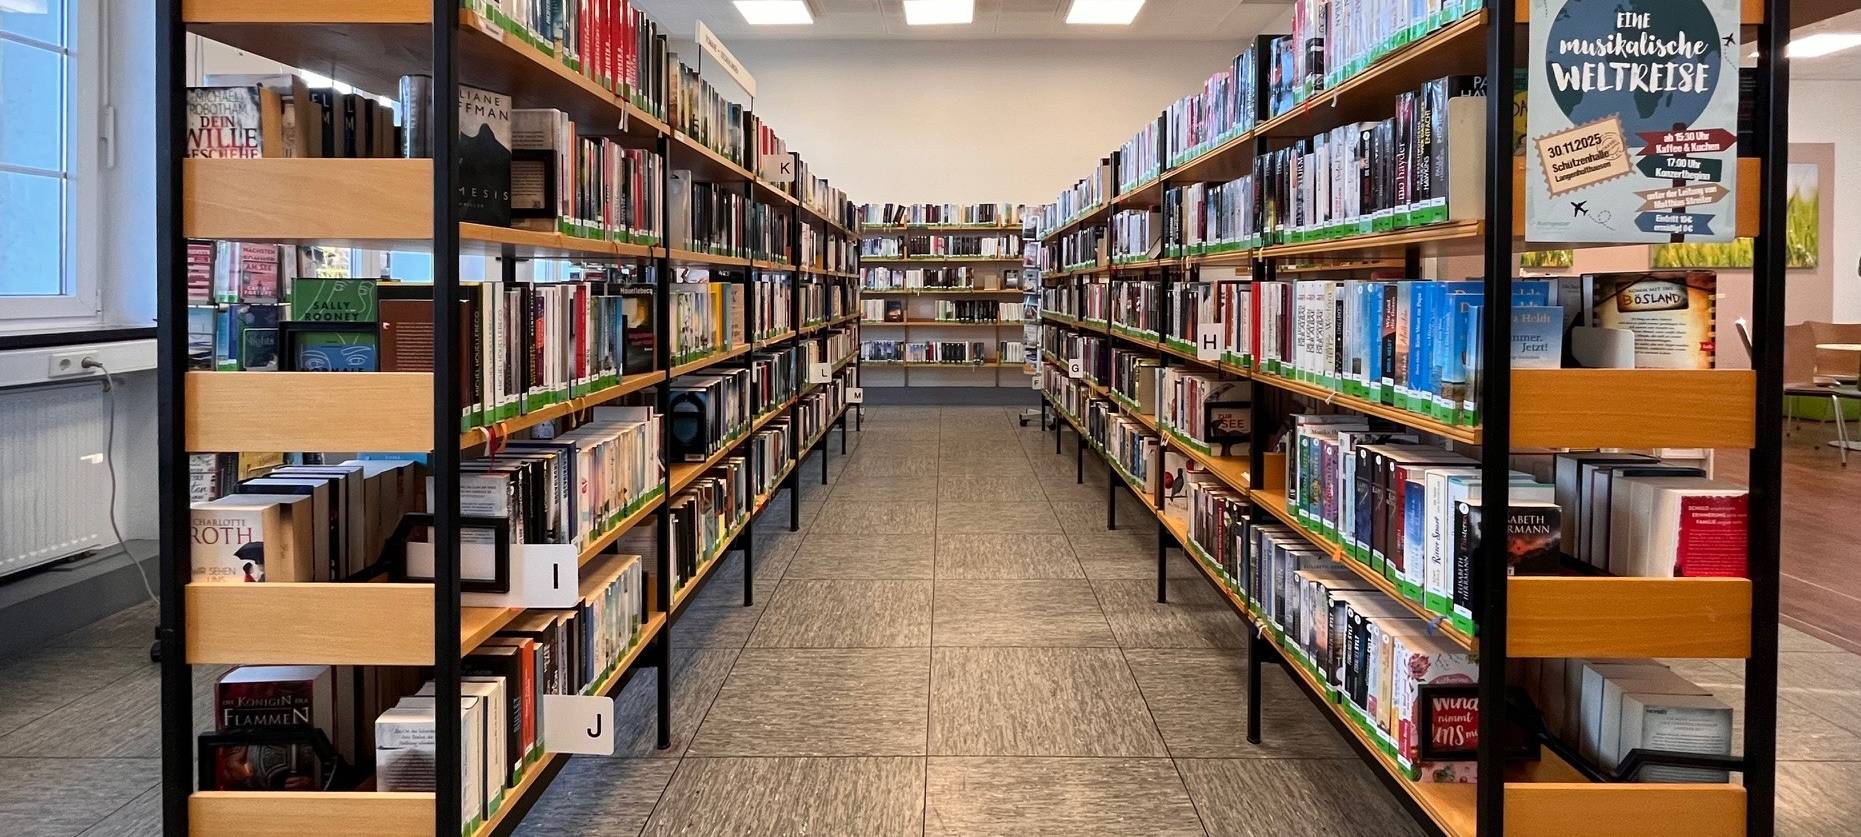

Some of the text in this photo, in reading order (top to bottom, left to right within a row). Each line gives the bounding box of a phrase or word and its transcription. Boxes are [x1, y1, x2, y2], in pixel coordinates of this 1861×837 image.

[1617, 12, 1651, 29] EINE
[1560, 31, 1709, 59] musikalische
[1551, 61, 1709, 93] WELTREISE
[201, 116, 235, 127] DEIN
[1664, 133, 1673, 142] ab
[1696, 131, 1709, 140] Uhr
[1656, 142, 1720, 153] Kaffee & Kuchen
[1396, 142, 1407, 179] hayder
[1688, 159, 1701, 168] Uhr
[780, 162, 790, 174] K
[1621, 292, 1681, 306] BÖSLAND
[312, 301, 351, 310] SALLY
[304, 312, 360, 321] ROONEY
[1203, 334, 1217, 350] H
[1521, 343, 1549, 353] Jetzt!
[821, 368, 828, 378] L
[1071, 364, 1079, 373] G
[1220, 419, 1245, 428] SEE
[193, 518, 246, 527] CHARLOTTE
[553, 563, 558, 589] I
[224, 707, 309, 726] FLAMMEN
[1438, 714, 1472, 723] nimmt
[587, 713, 602, 738] J
